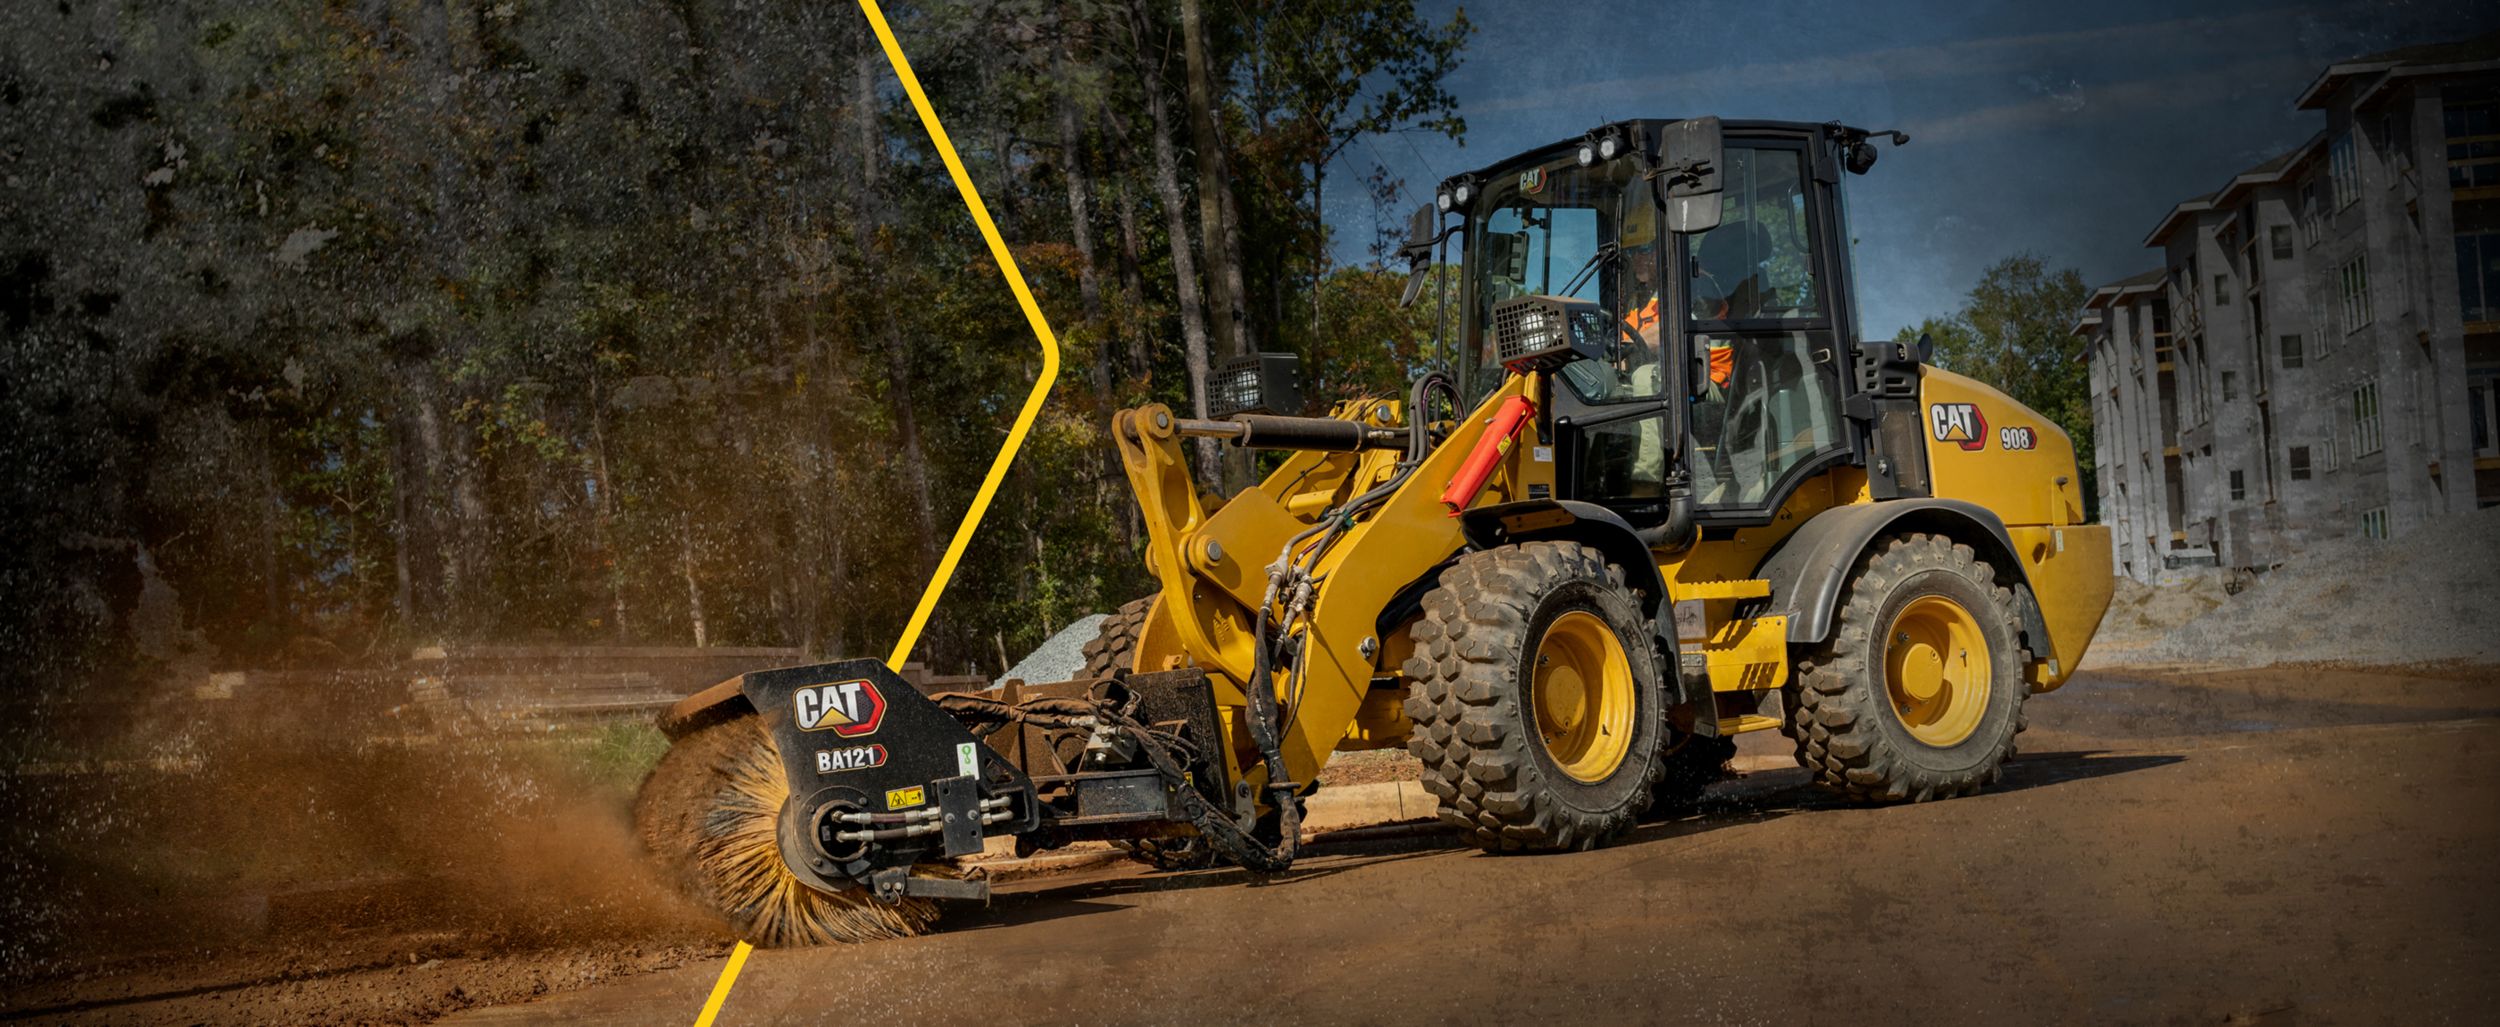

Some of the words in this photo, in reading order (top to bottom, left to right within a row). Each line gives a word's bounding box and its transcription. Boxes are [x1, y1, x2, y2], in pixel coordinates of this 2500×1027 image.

[1520, 168, 1539, 190] CAT
[1931, 404, 1973, 441] CAT
[2001, 428, 2030, 449] 908
[795, 682, 861, 729] CAT
[818, 747, 875, 772] BA121
